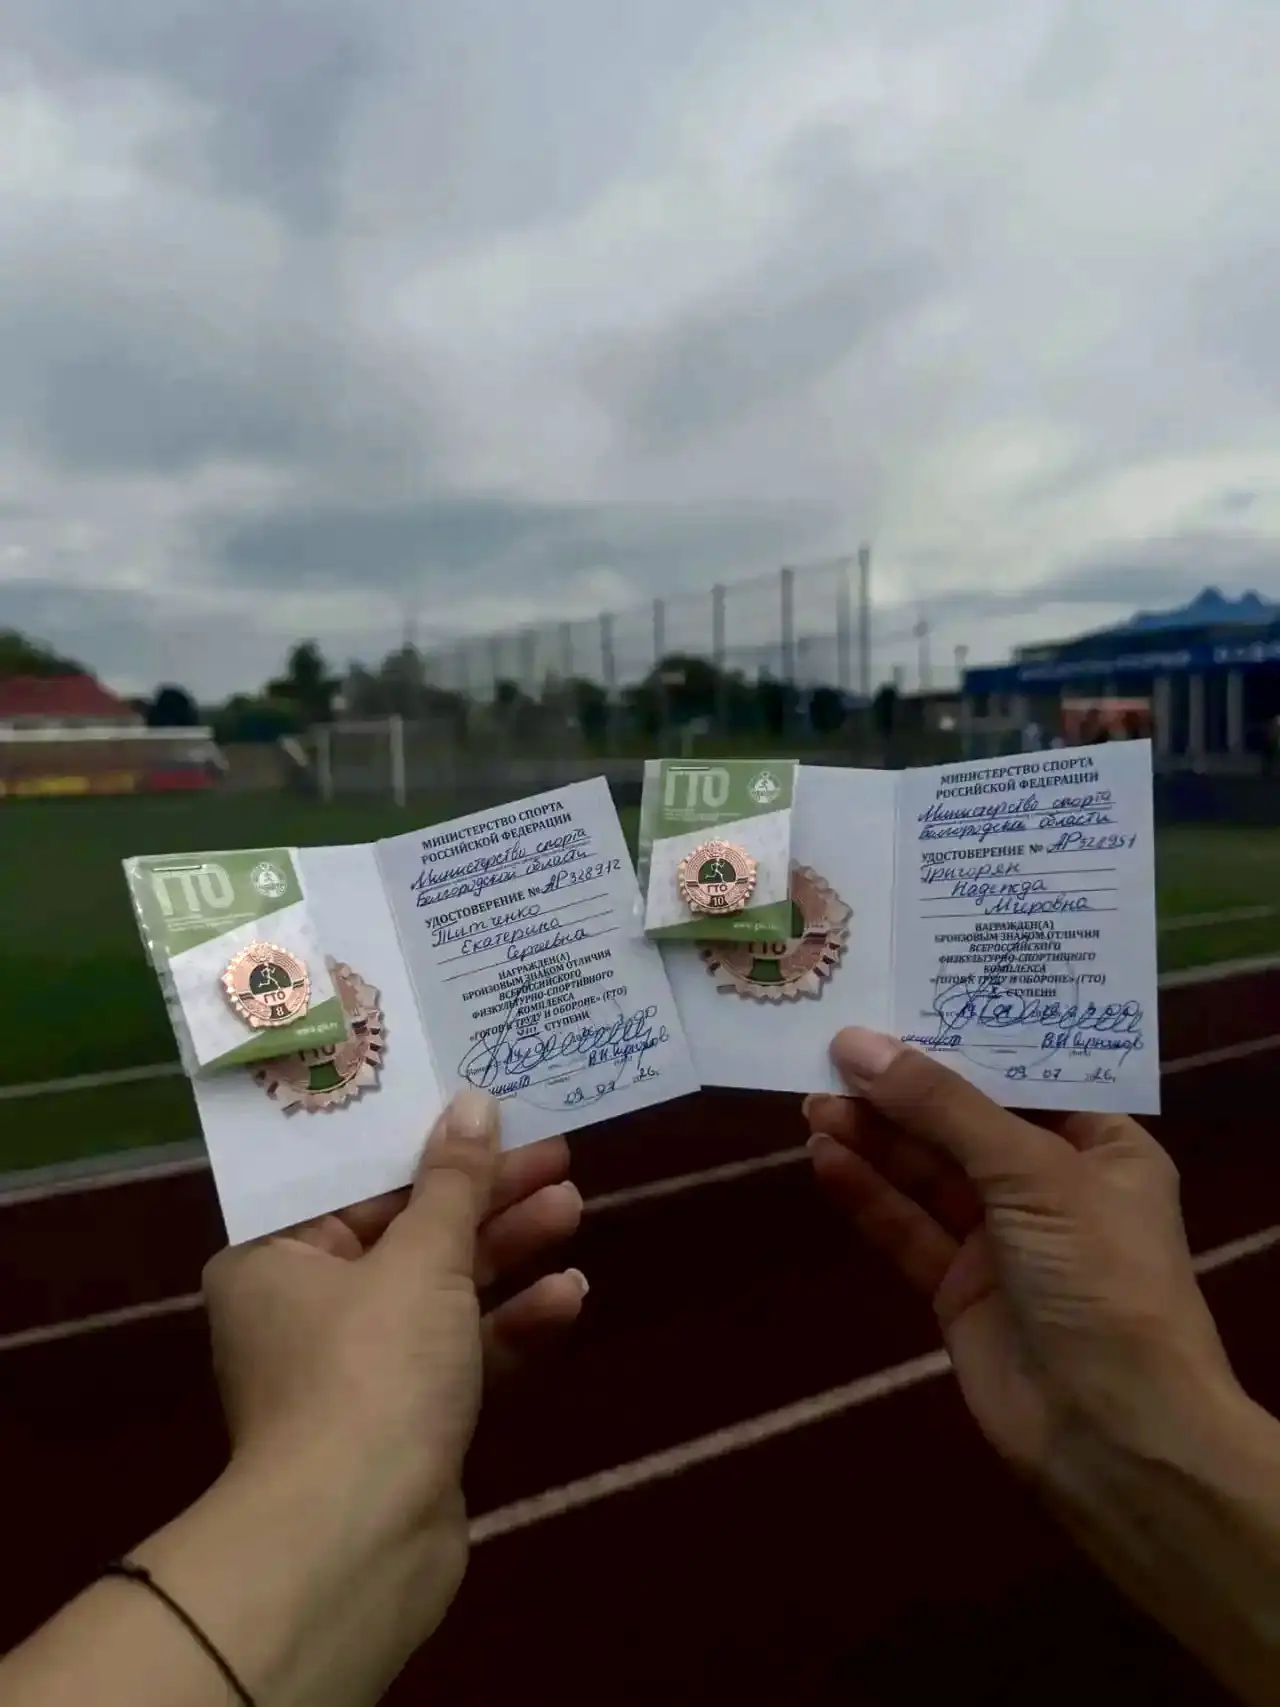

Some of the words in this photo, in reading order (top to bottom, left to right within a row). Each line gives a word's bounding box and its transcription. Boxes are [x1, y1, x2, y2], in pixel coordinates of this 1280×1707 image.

[940, 766, 1040, 785] МИНИСТЕРСТВО
[1043, 756, 1094, 773] СПОРТА
[664, 767, 730, 807] ГТО
[936, 779, 1016, 800] РОССИЙСКОЙ
[1019, 771, 1099, 789] ФЕДЕРАЦИИ
[420, 834, 500, 865] РОССИЙСКОЙ
[501, 812, 572, 841] ФЕДЕРАЦИИ
[421, 814, 517, 850] МИНИСТЕРСТВО
[518, 801, 565, 822] СПОРТА
[921, 846, 1024, 864] УДОСТОВЕРЕНИЕ
[1029, 843, 1044, 854] №
[152, 863, 235, 917] ГТО
[707, 884, 729, 893] ГТО
[712, 896, 725, 907] 10
[425, 890, 525, 928] УДОСТОВЕРЕНИЕ
[528, 883, 541, 898] №
[935, 933, 998, 943] БРОНЗОВЫМ
[1000, 931, 1044, 942] ЗНАКОМ
[1047, 930, 1100, 940] ОТЛИЧИЯ
[975, 920, 1054, 932] НАГРАЖДЕН(А)
[969, 941, 1061, 953] ВСЕРОССИЙСКОГО
[462, 976, 526, 1002] БРОНЗОВЫМ
[525, 963, 565, 985] ЗНАКОМ
[566, 948, 611, 973] ОТЛИЧИЯ
[498, 952, 571, 980] НАГРАЖДЕН(А)
[263, 990, 286, 1004] ГТО
[472, 970, 614, 1019] ФИЗКУЛЬТУРНО-СПОРТИВНОГО
[499, 969, 582, 1001] ВСЕРОССИЙСКОГО
[1006, 988, 1056, 998] СТУПЕНИ
[275, 1006, 284, 1016] 8
[516, 993, 574, 1018] КОМПЛЕКСА
[544, 1011, 590, 1032] СТУПЕНИ
